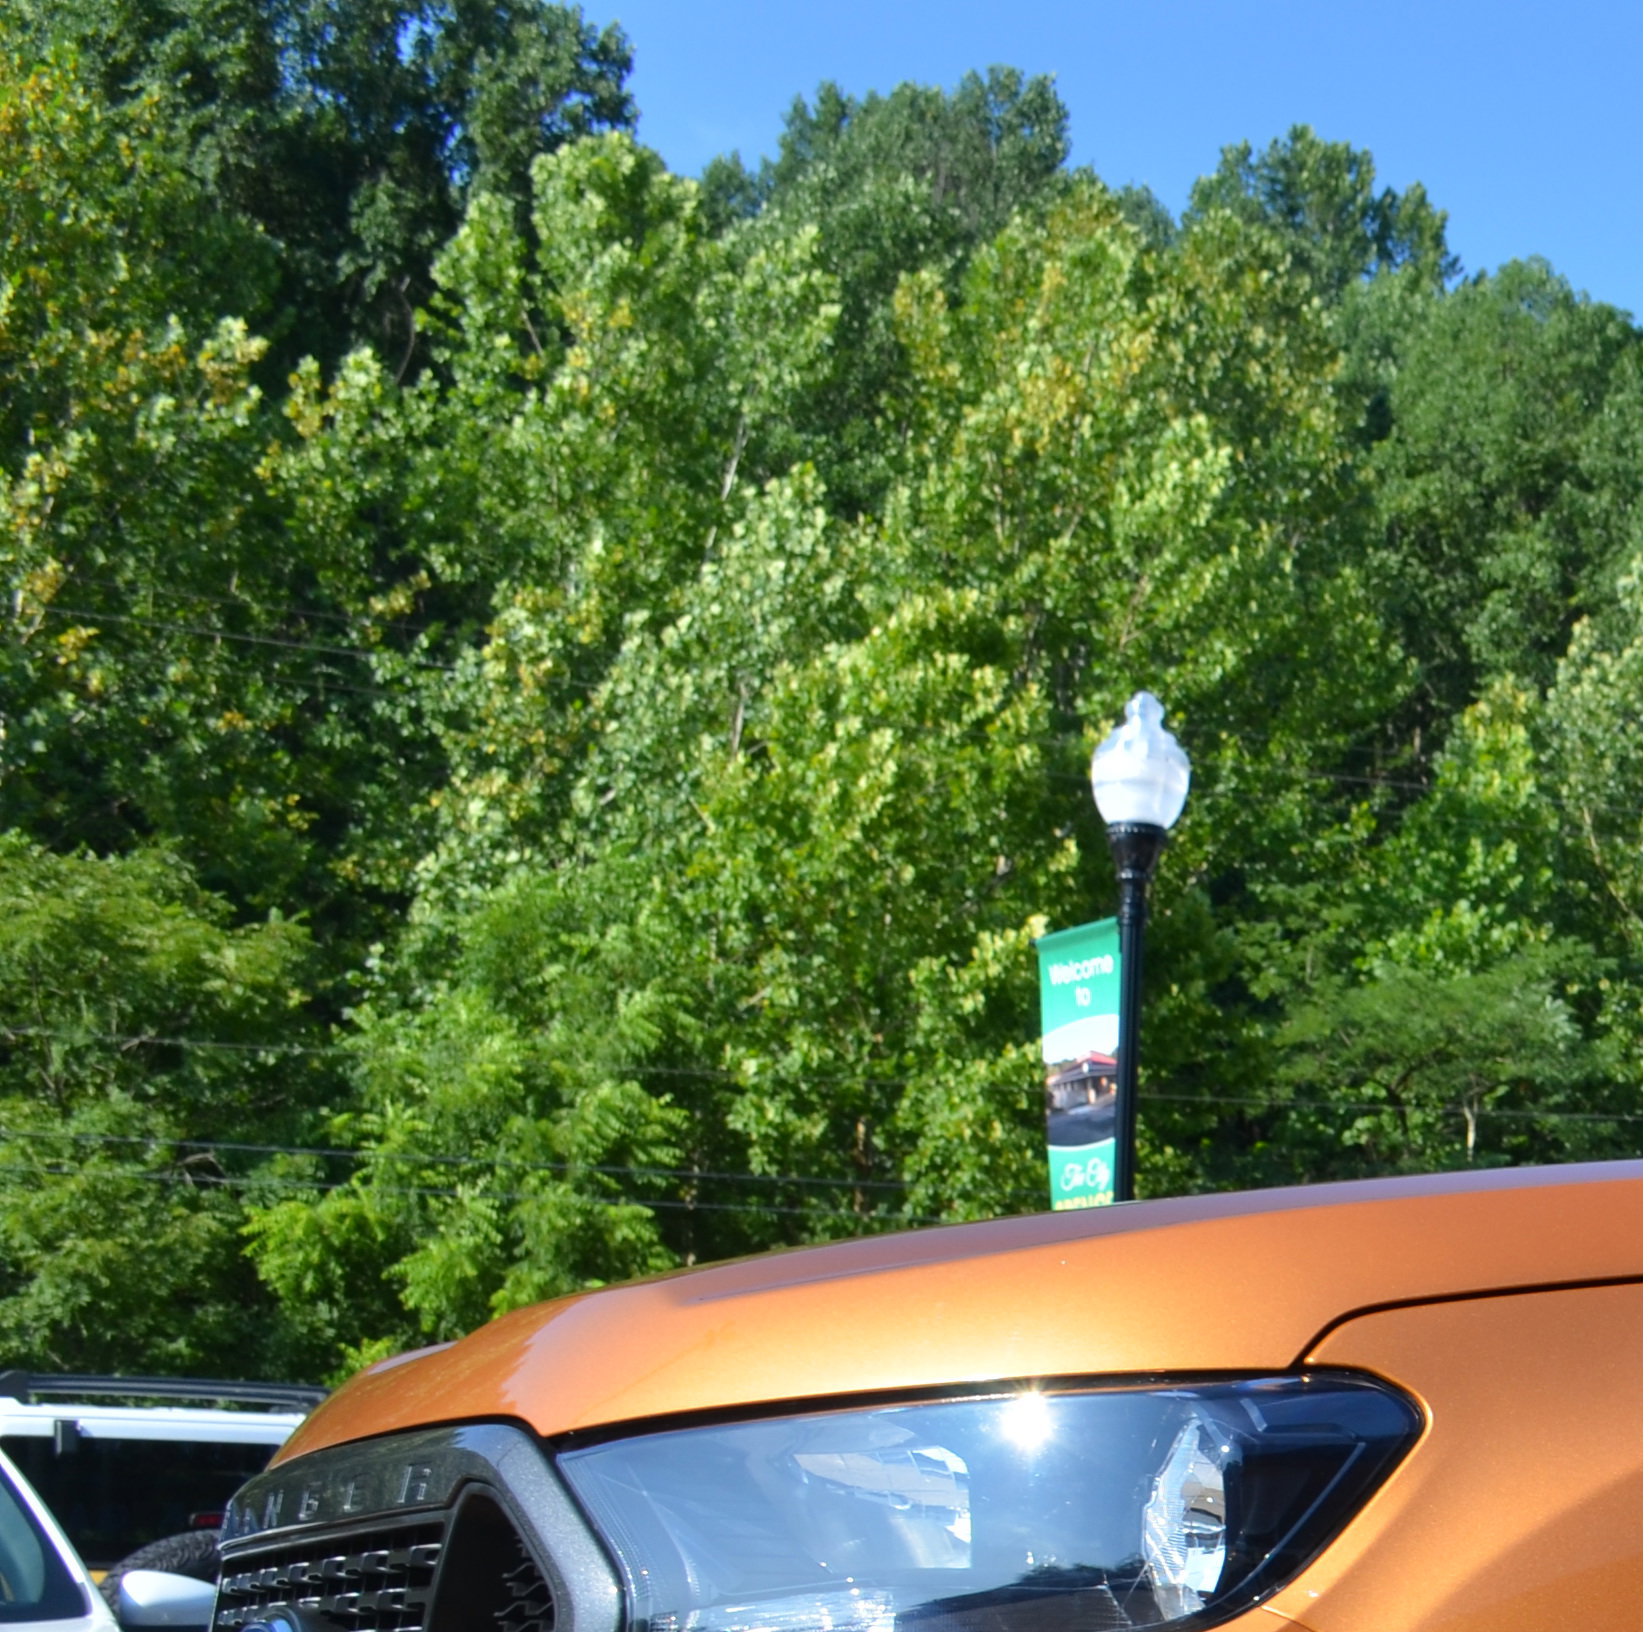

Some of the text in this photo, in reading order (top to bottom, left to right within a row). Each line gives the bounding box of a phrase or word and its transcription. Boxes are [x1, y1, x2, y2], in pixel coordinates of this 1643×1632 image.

[1048, 953, 1114, 986] Welcome
[1075, 986, 1091, 1007] to
[1060, 1157, 1110, 1192] The City
